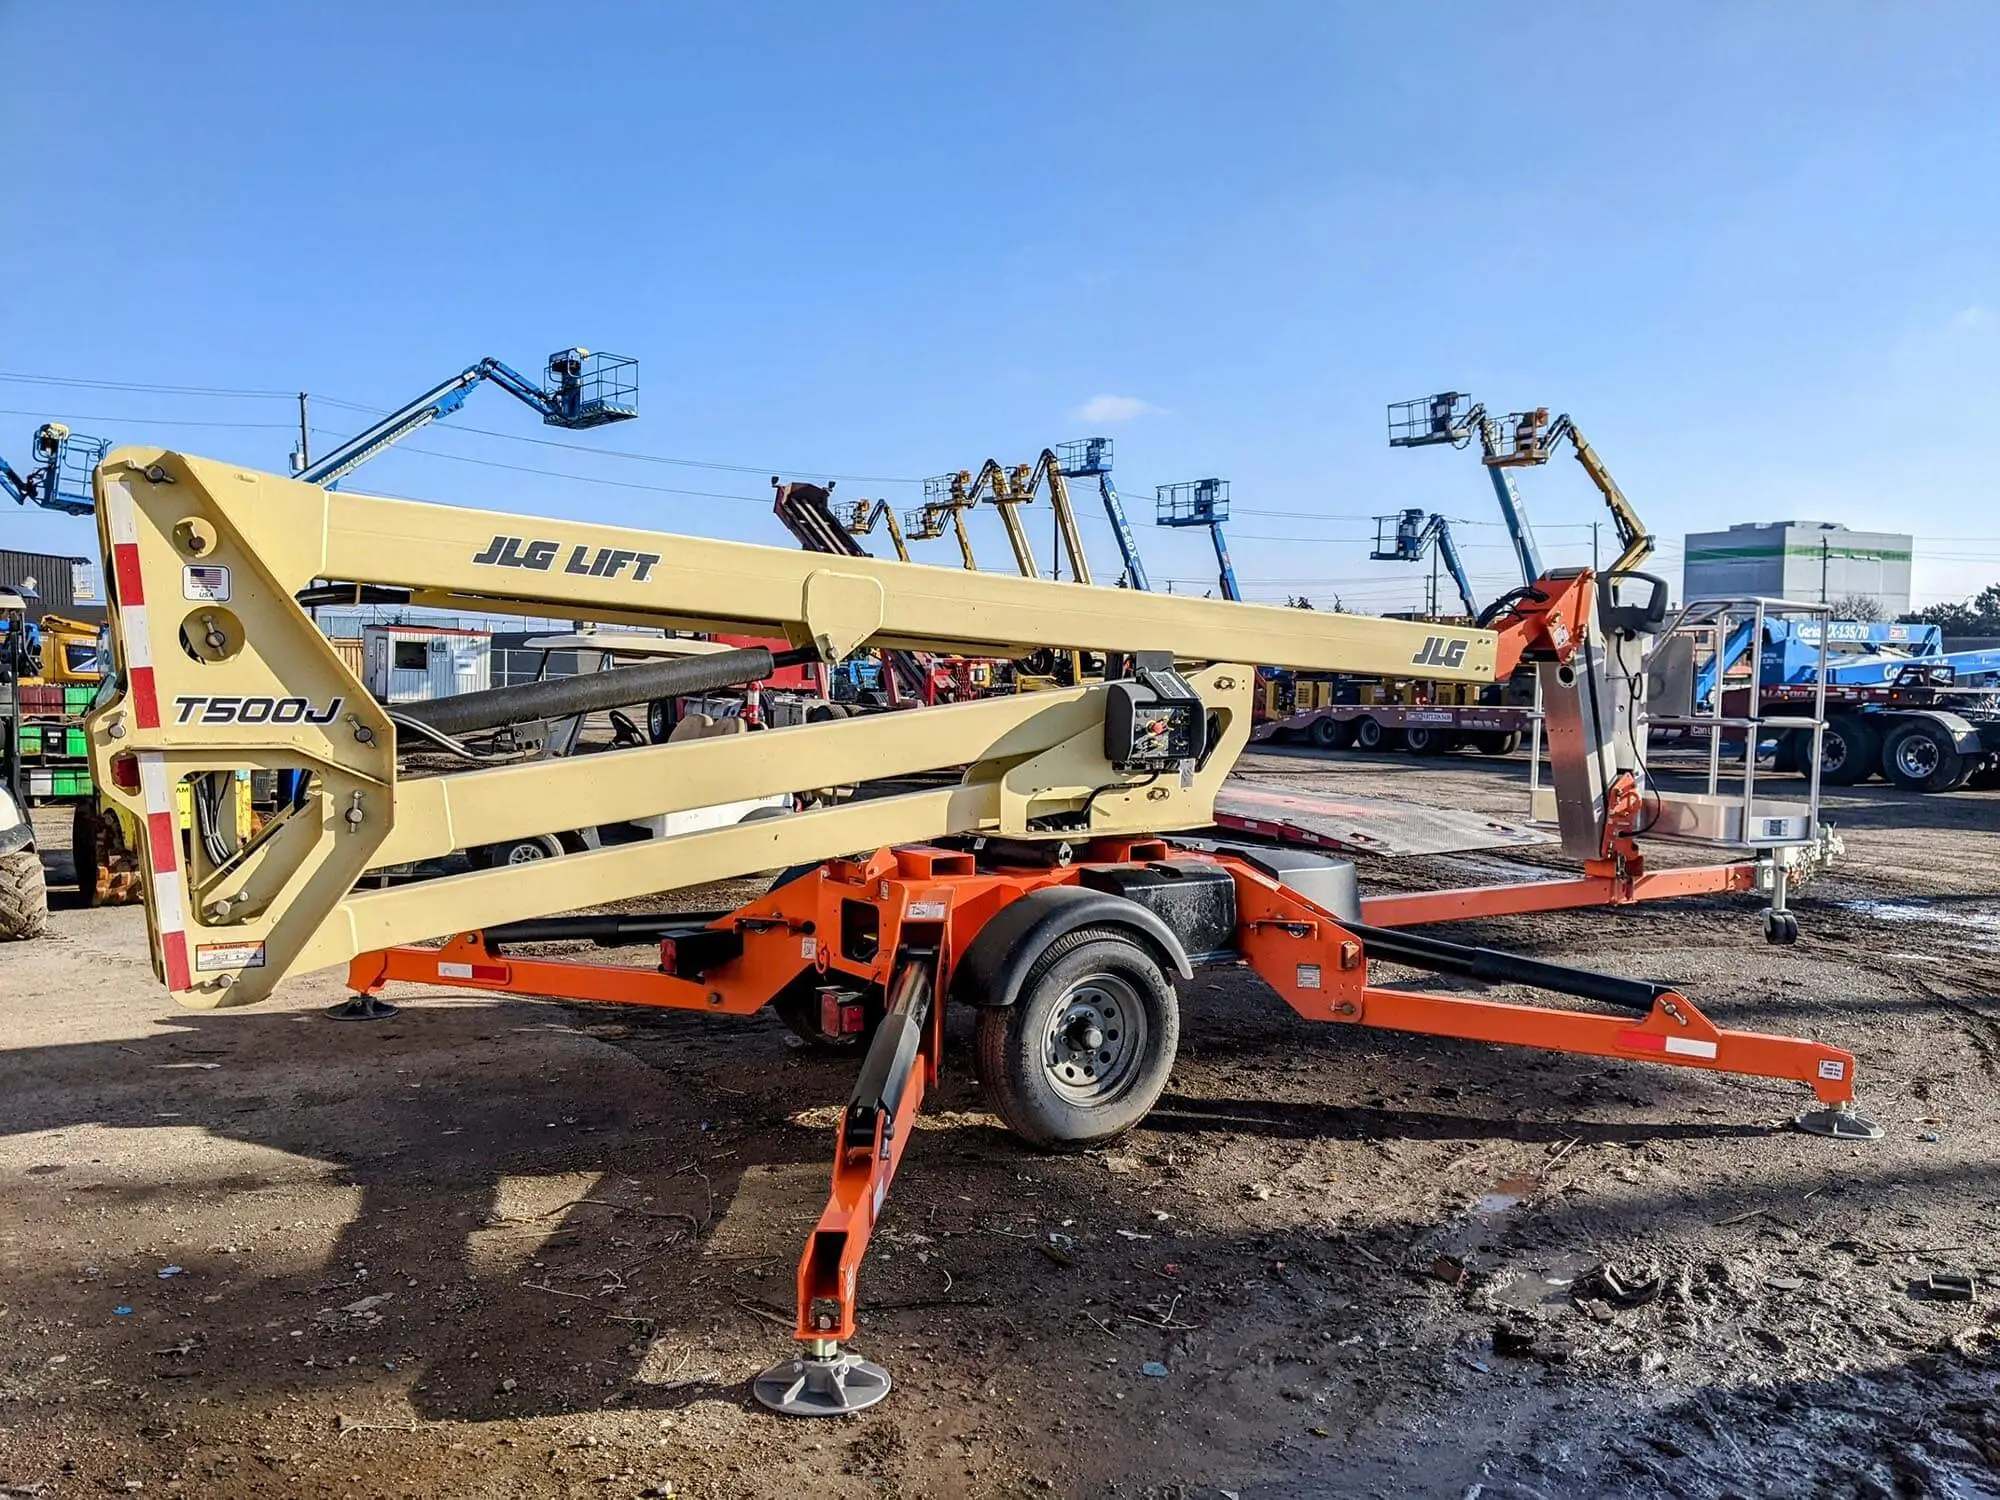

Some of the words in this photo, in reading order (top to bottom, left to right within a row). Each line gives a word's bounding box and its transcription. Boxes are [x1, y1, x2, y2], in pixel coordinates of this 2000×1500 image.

[472, 535, 561, 571] JLG
[564, 545, 661, 581] LIFT
[1412, 637, 1468, 668] JLG
[174, 697, 343, 724] T500J
